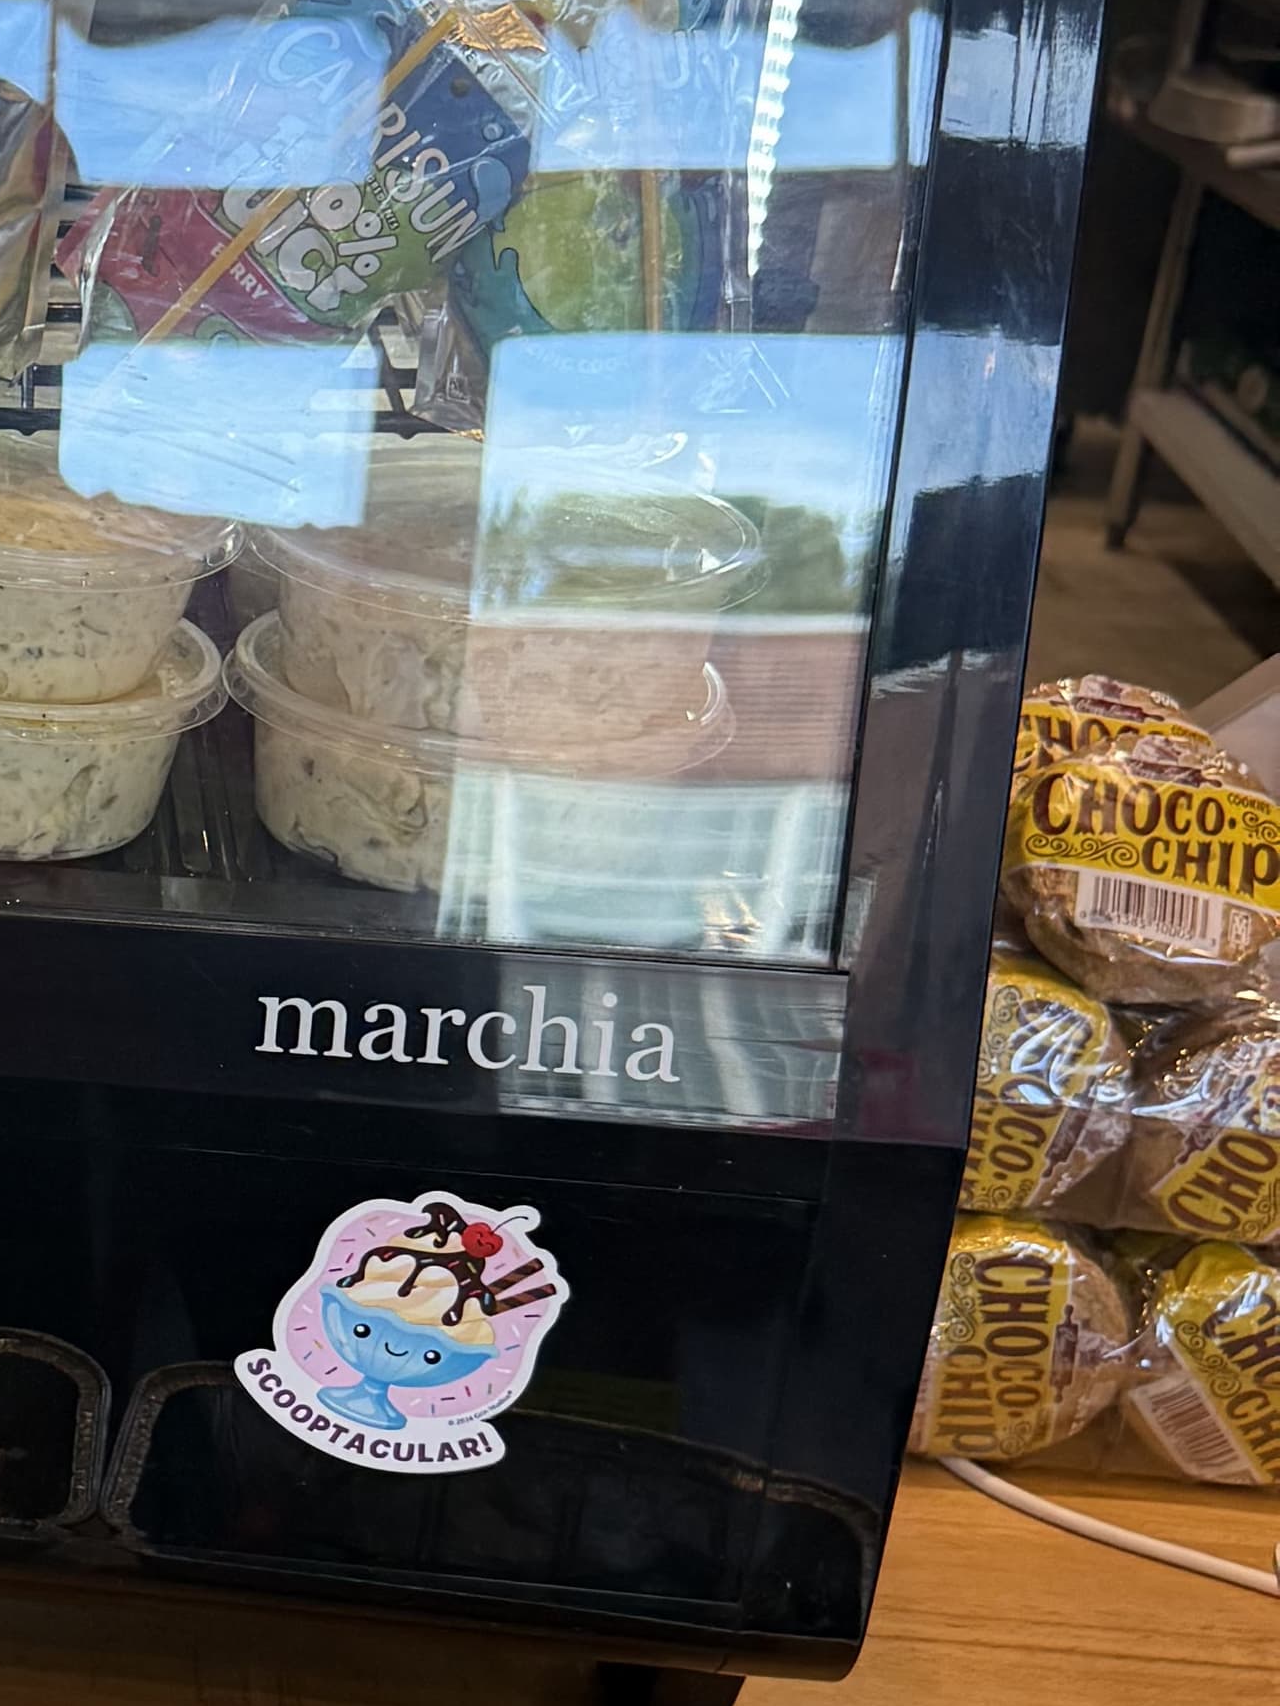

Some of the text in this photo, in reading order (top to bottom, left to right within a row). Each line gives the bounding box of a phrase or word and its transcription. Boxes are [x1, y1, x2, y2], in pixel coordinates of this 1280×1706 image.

[386, 148, 486, 263] SUN
[1141, 836, 1280, 899] CHIP
[254, 985, 680, 1083] marchia
[247, 1356, 493, 1463] SCOOPTACULAR!
[934, 1345, 999, 1454] CHIP
